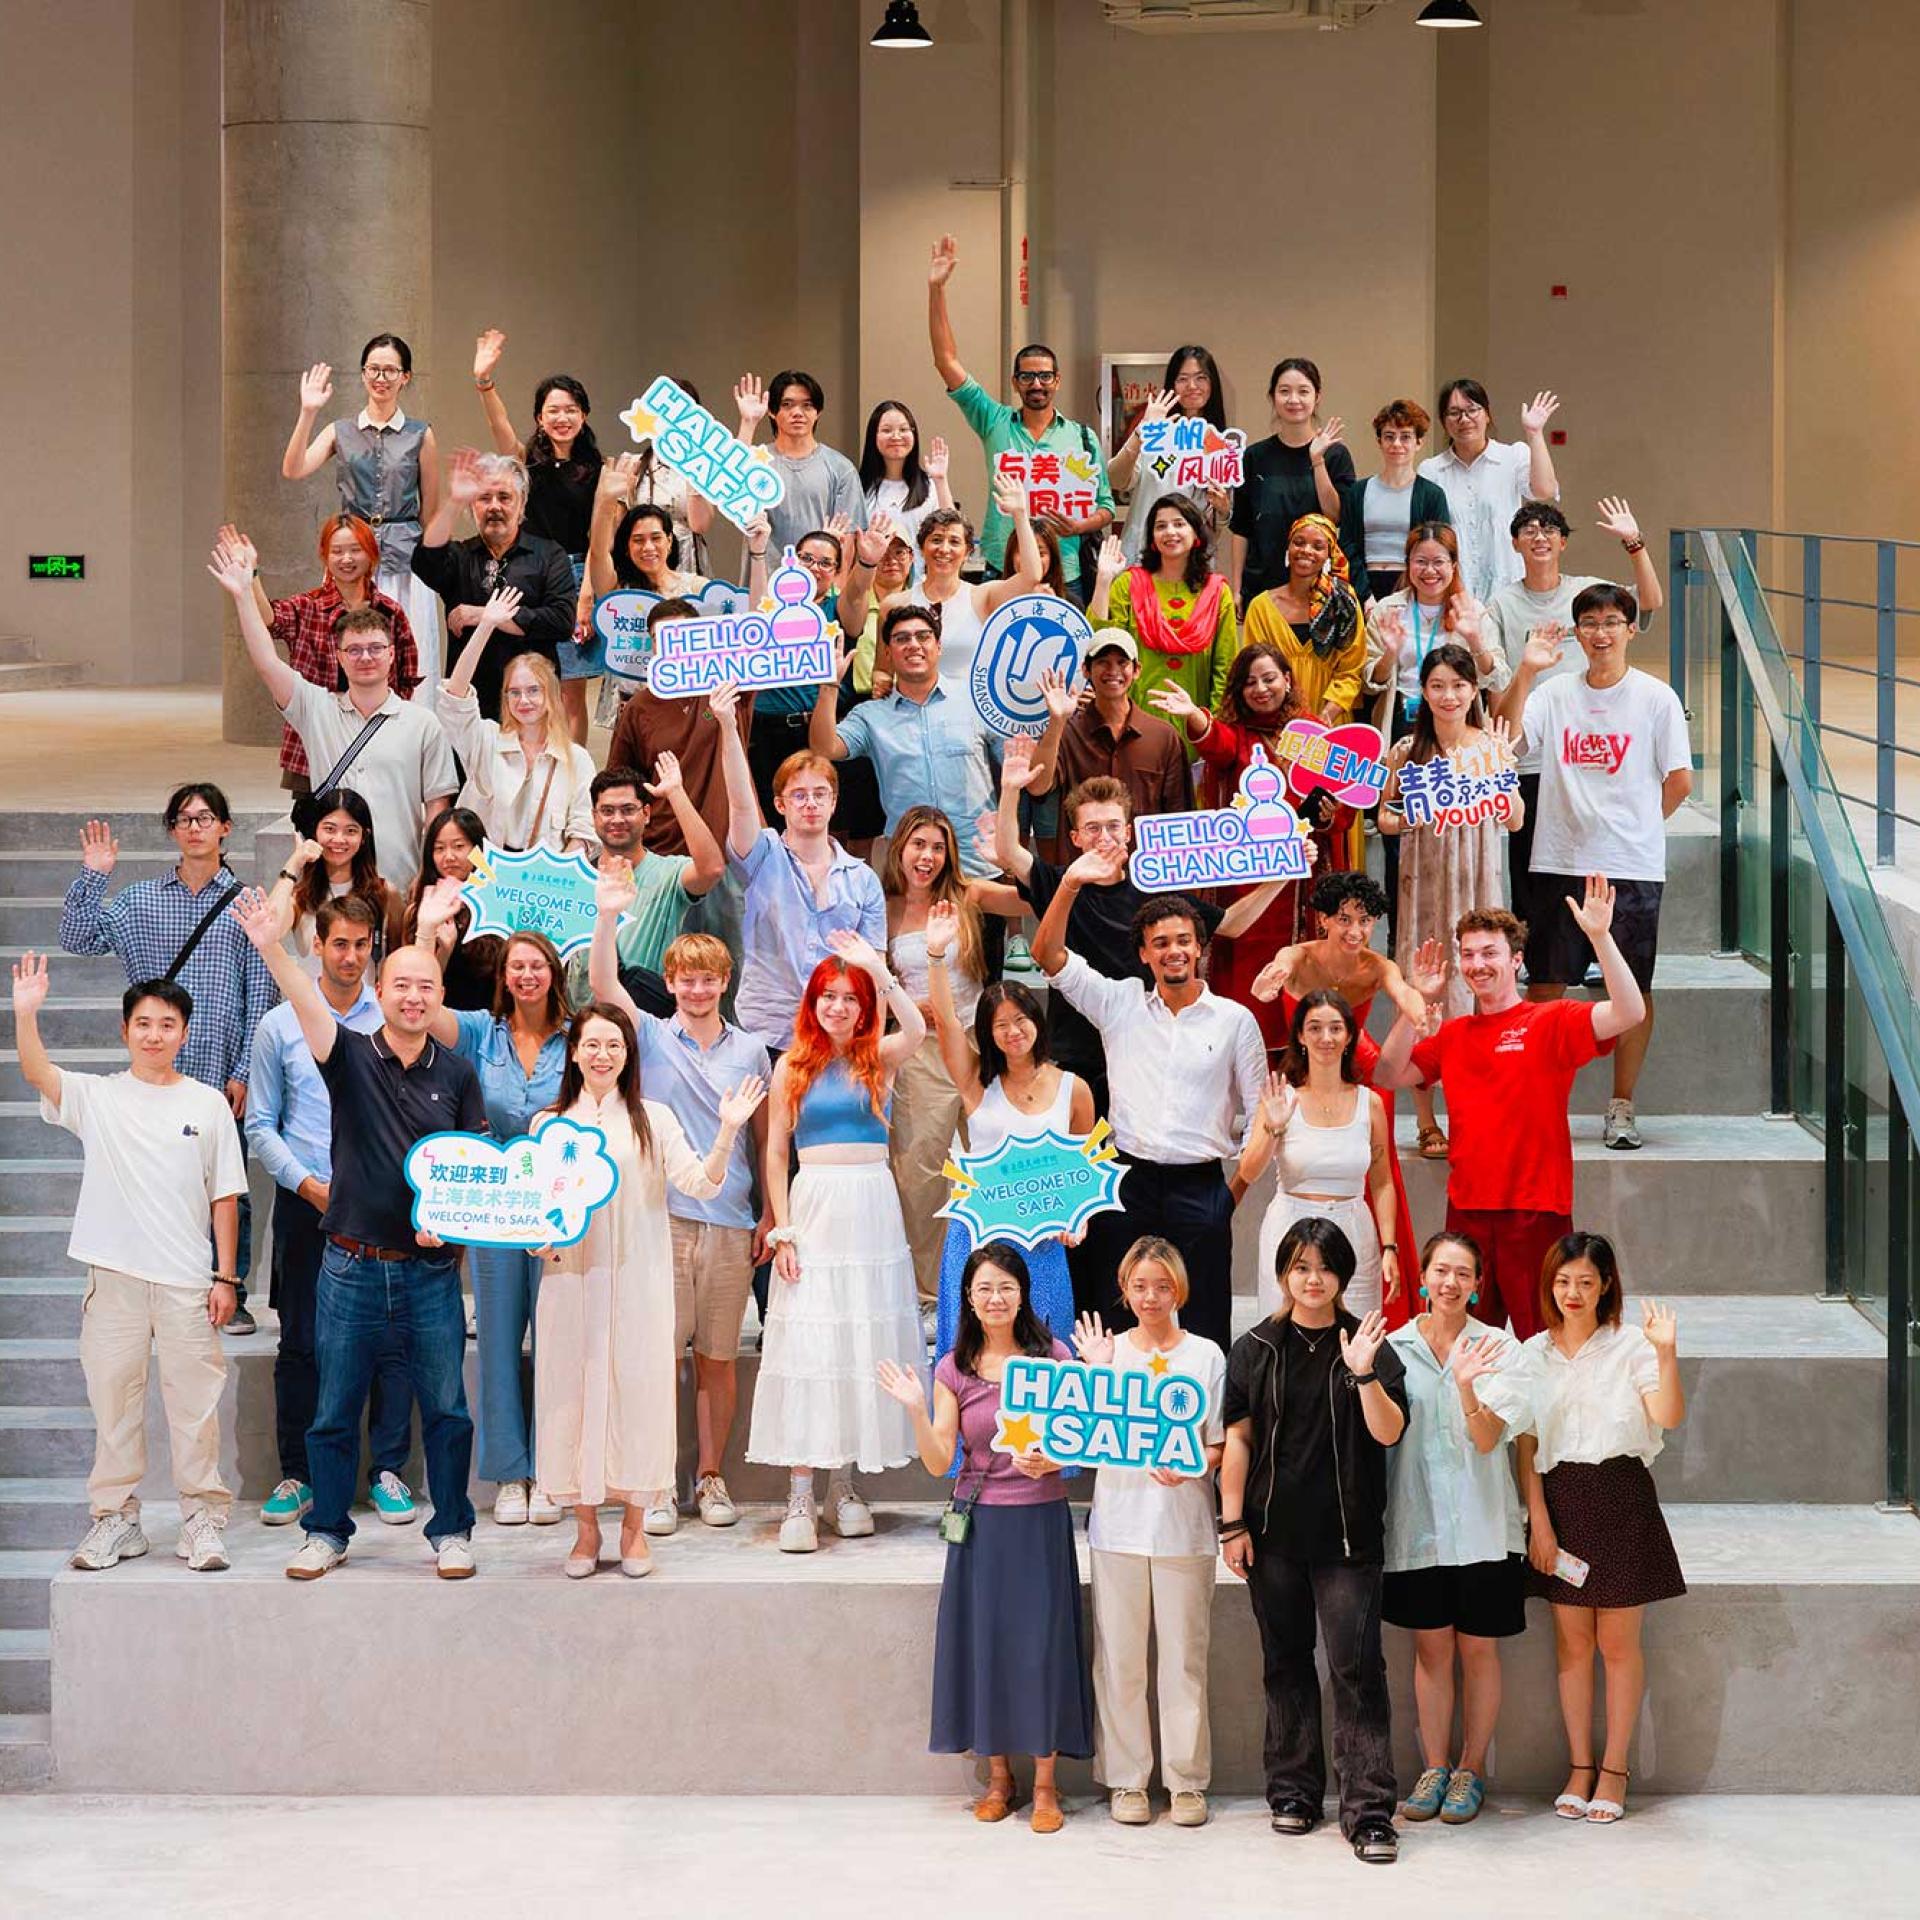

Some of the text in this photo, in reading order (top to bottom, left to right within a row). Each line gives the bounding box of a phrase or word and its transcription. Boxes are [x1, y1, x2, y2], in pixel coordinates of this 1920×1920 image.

[648, 384, 778, 501] HALLO
[1142, 421, 1205, 452] 艺帆
[660, 430, 757, 525] SAFA
[1177, 455, 1241, 486] 风顺
[1029, 490, 1093, 519] 同行
[667, 621, 765, 653] HELLO
[659, 645, 825, 688] SHANGHAI
[974, 665, 1010, 730] SHANGHAI
[1434, 793, 1511, 835] young
[1147, 819, 1240, 850] HELLO
[1141, 844, 1300, 882] SHANGHAI
[495, 886, 598, 918] WELCOME TO
[521, 910, 565, 931] SAFA
[429, 1163, 508, 1185] 欢迎来到
[980, 1168, 1091, 1201] WELCOME TO
[425, 1187, 542, 1210] 上海美术学院
[1017, 1195, 1064, 1217] SAFA
[427, 1210, 540, 1226] WELCOME to SAFA
[1010, 1366, 1200, 1422] HALLO
[1050, 1414, 1197, 1467] SAFA
